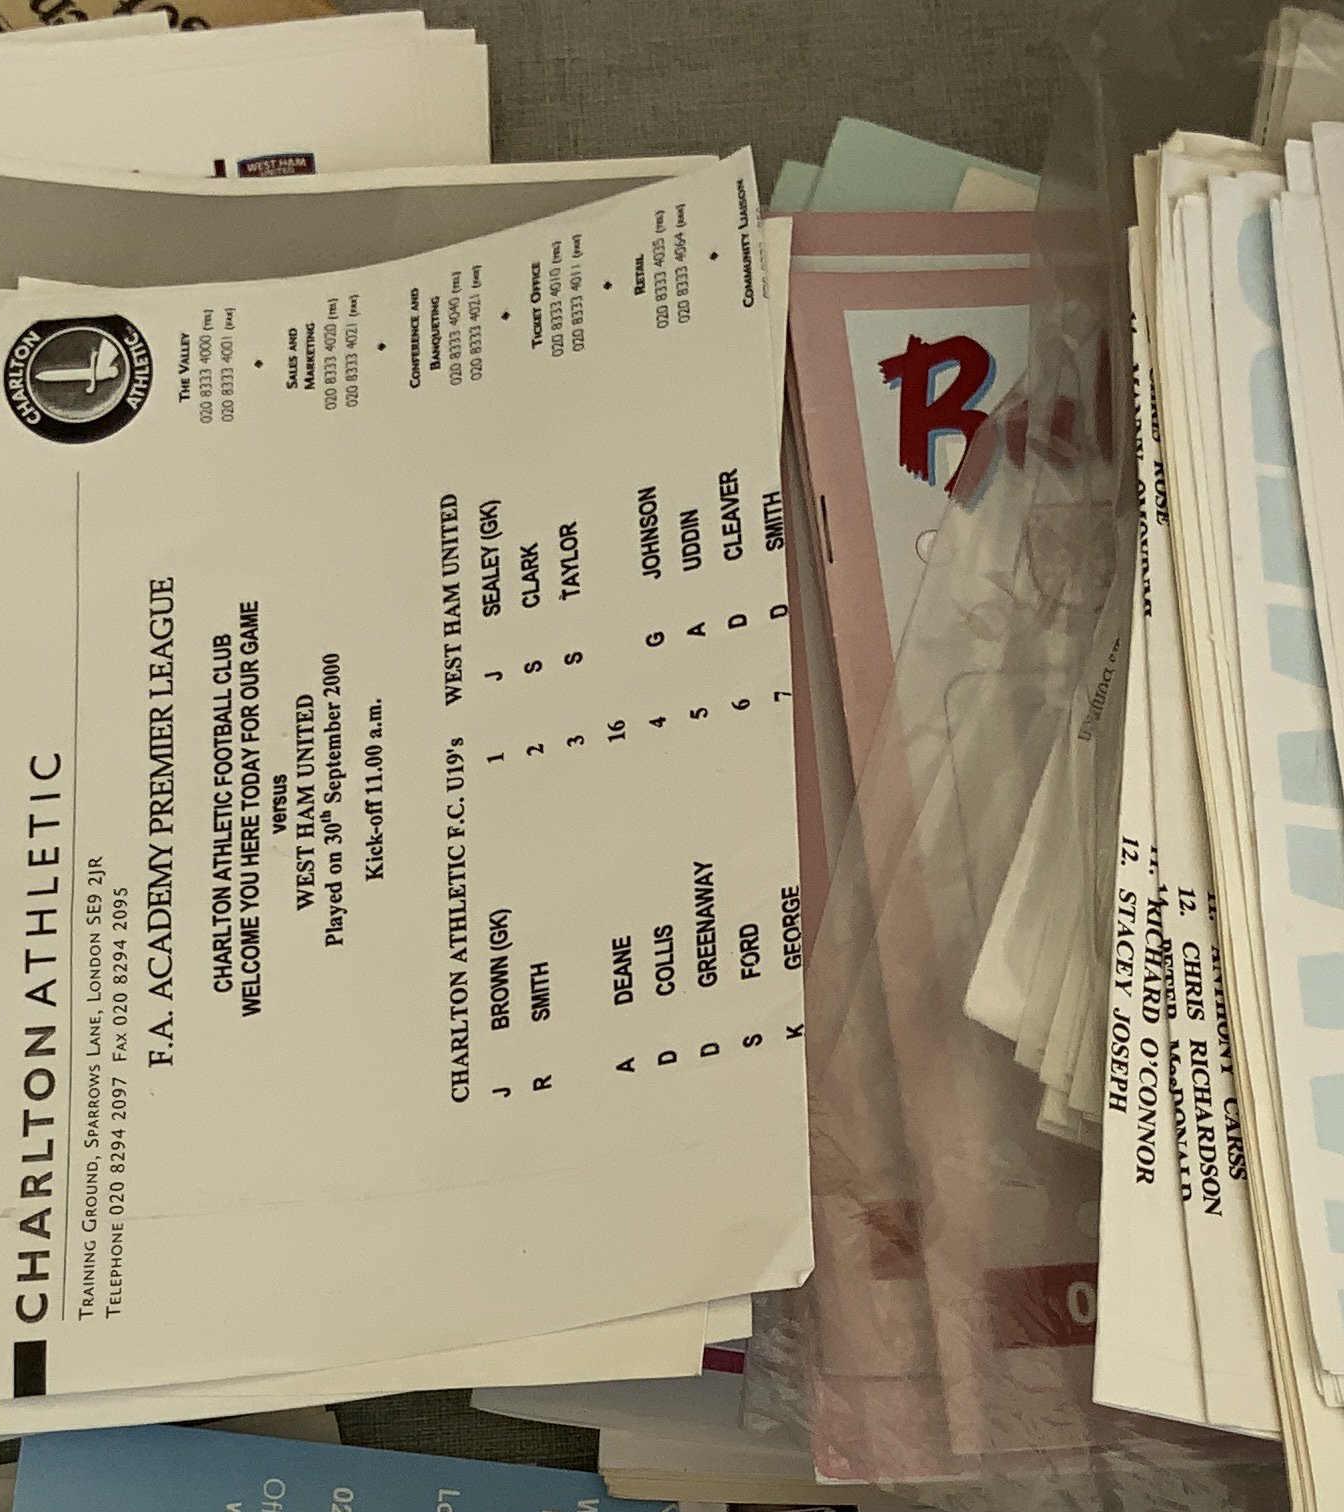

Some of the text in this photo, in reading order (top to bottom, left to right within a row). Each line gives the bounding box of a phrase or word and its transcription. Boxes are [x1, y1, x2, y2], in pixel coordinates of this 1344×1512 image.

[6, 331, 41, 425] CHARLTON
[638, 486, 661, 579] JOHNSON
[680, 509, 701, 571] UDDIN
[719, 468, 743, 561] CLEAVER
[440, 494, 463, 707] WEST HAM UNITED
[520, 543, 540, 608] CLARK
[559, 521, 580, 601] TAYLOR
[323, 653, 340, 697] 2000
[323, 702, 346, 804] September
[365, 698, 384, 882] Kick-off 11.00 a.m.
[147, 577, 175, 1068] F.A. ACADEMY PREMIER LEAGUE
[212, 633, 234, 993] CHARLTON ATHLETIC FOOTBALL CLUB
[272, 774, 287, 835] versus
[296, 694, 315, 912] WEST HAM UNITED
[447, 797, 466, 839] F.C.
[88, 857, 106, 886] 2JR
[326, 852, 343, 875] on
[448, 844, 467, 964] ATHLETIC
[1178, 887, 1196, 916] 12.
[86, 894, 102, 925] SE9
[325, 880, 348, 948] Played
[693, 862, 717, 987] GREENAWAY
[739, 924, 761, 980] FORD
[612, 936, 633, 1005] DEANE
[654, 925, 675, 996] COLLIS
[1109, 888, 1137, 1113] STACEY JOSEPH
[1182, 942, 1204, 1020] CHRIS
[16, 753, 61, 1323] CHARLTON ATHLETIC
[450, 970, 470, 1104] CHARLTON
[1190, 1039, 1222, 1216] RICHARDSON
